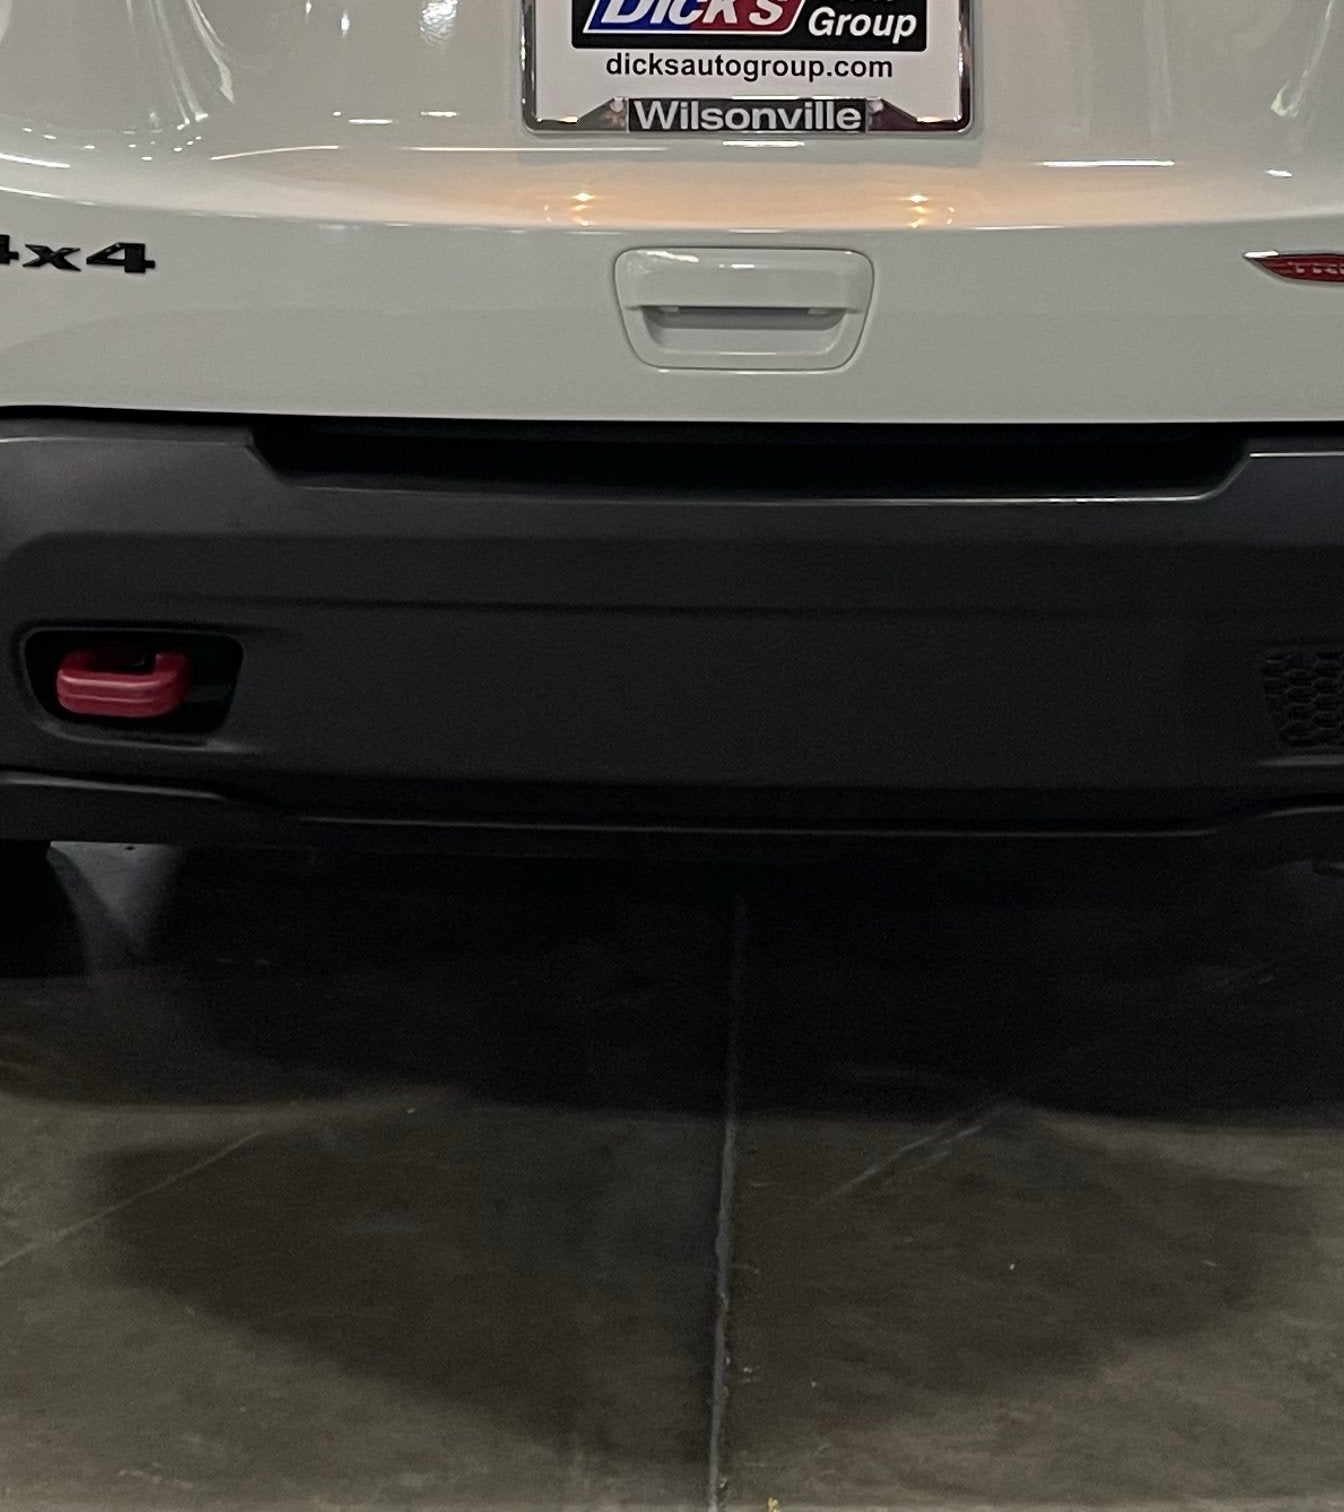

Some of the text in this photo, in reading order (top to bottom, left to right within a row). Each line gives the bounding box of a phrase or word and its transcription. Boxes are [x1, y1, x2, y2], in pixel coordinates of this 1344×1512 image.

[808, 8, 917, 44] Group
[606, 53, 893, 81] dicksautogroup.com
[634, 100, 861, 132] Wilsonville
